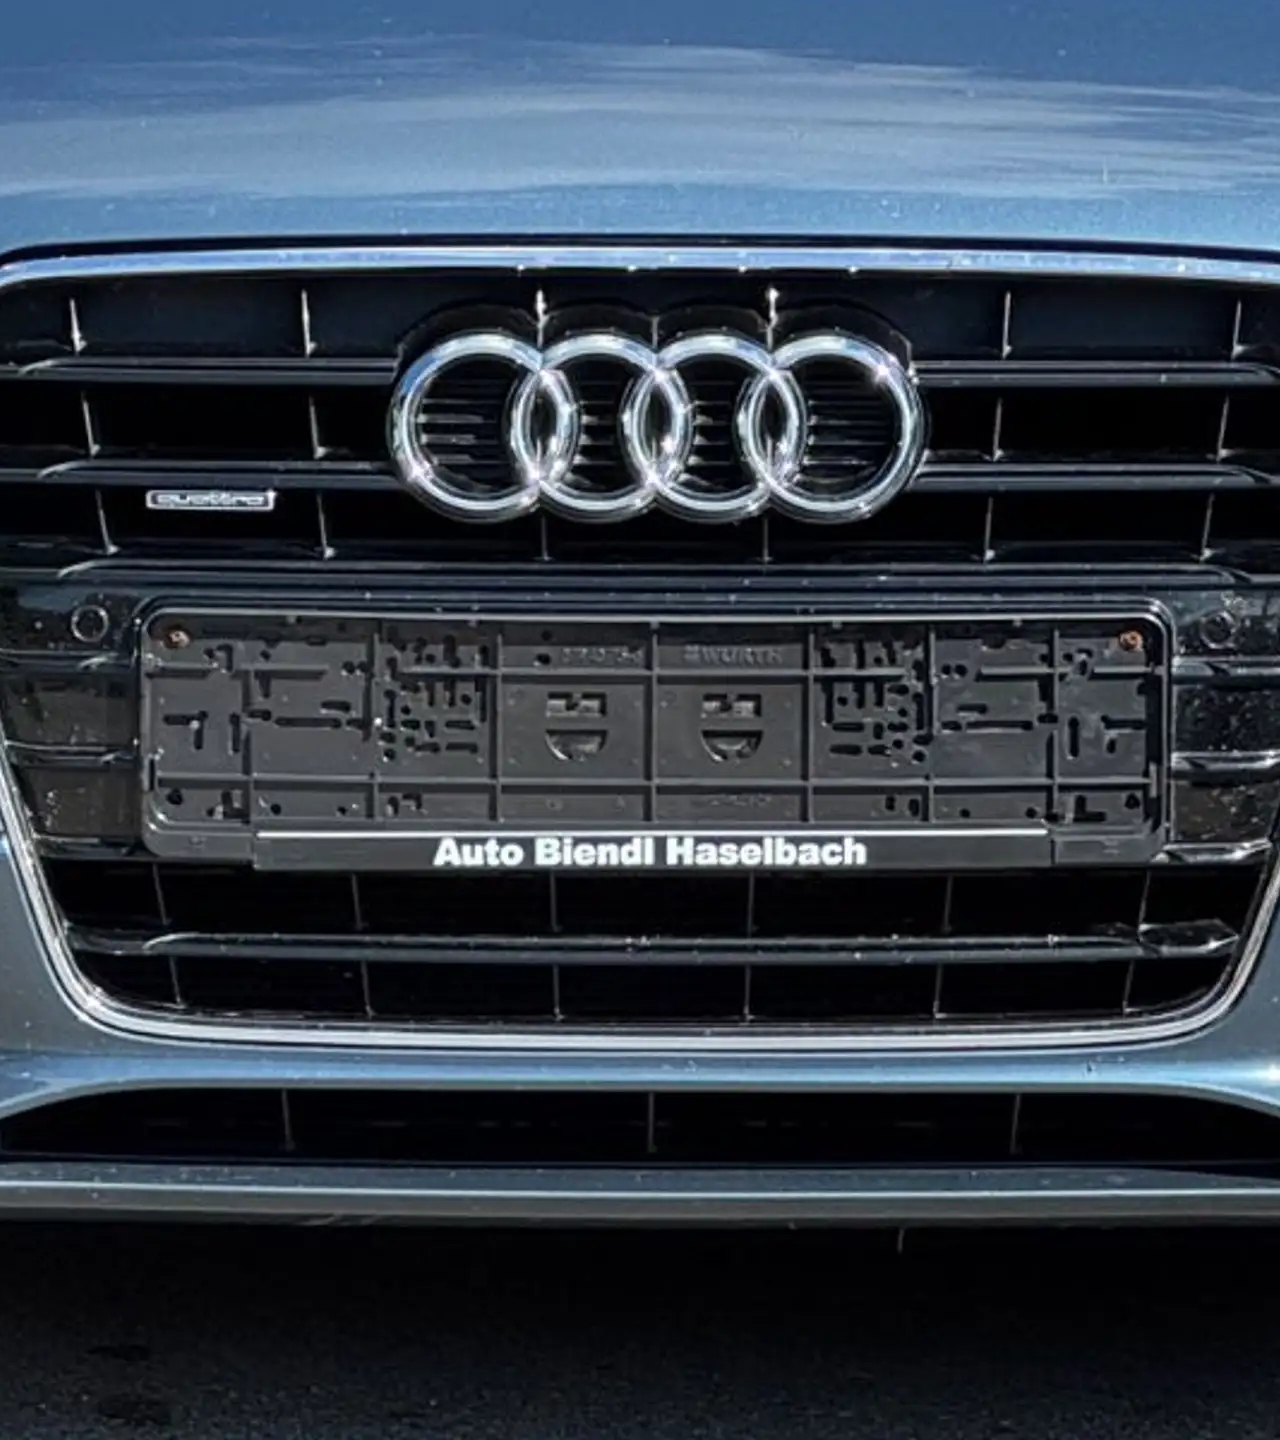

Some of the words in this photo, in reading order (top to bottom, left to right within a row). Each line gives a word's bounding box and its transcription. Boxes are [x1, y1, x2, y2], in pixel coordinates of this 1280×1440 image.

[433, 837, 524, 866] Auto
[535, 837, 655, 866] Biendl
[666, 837, 868, 866] Haselbach
